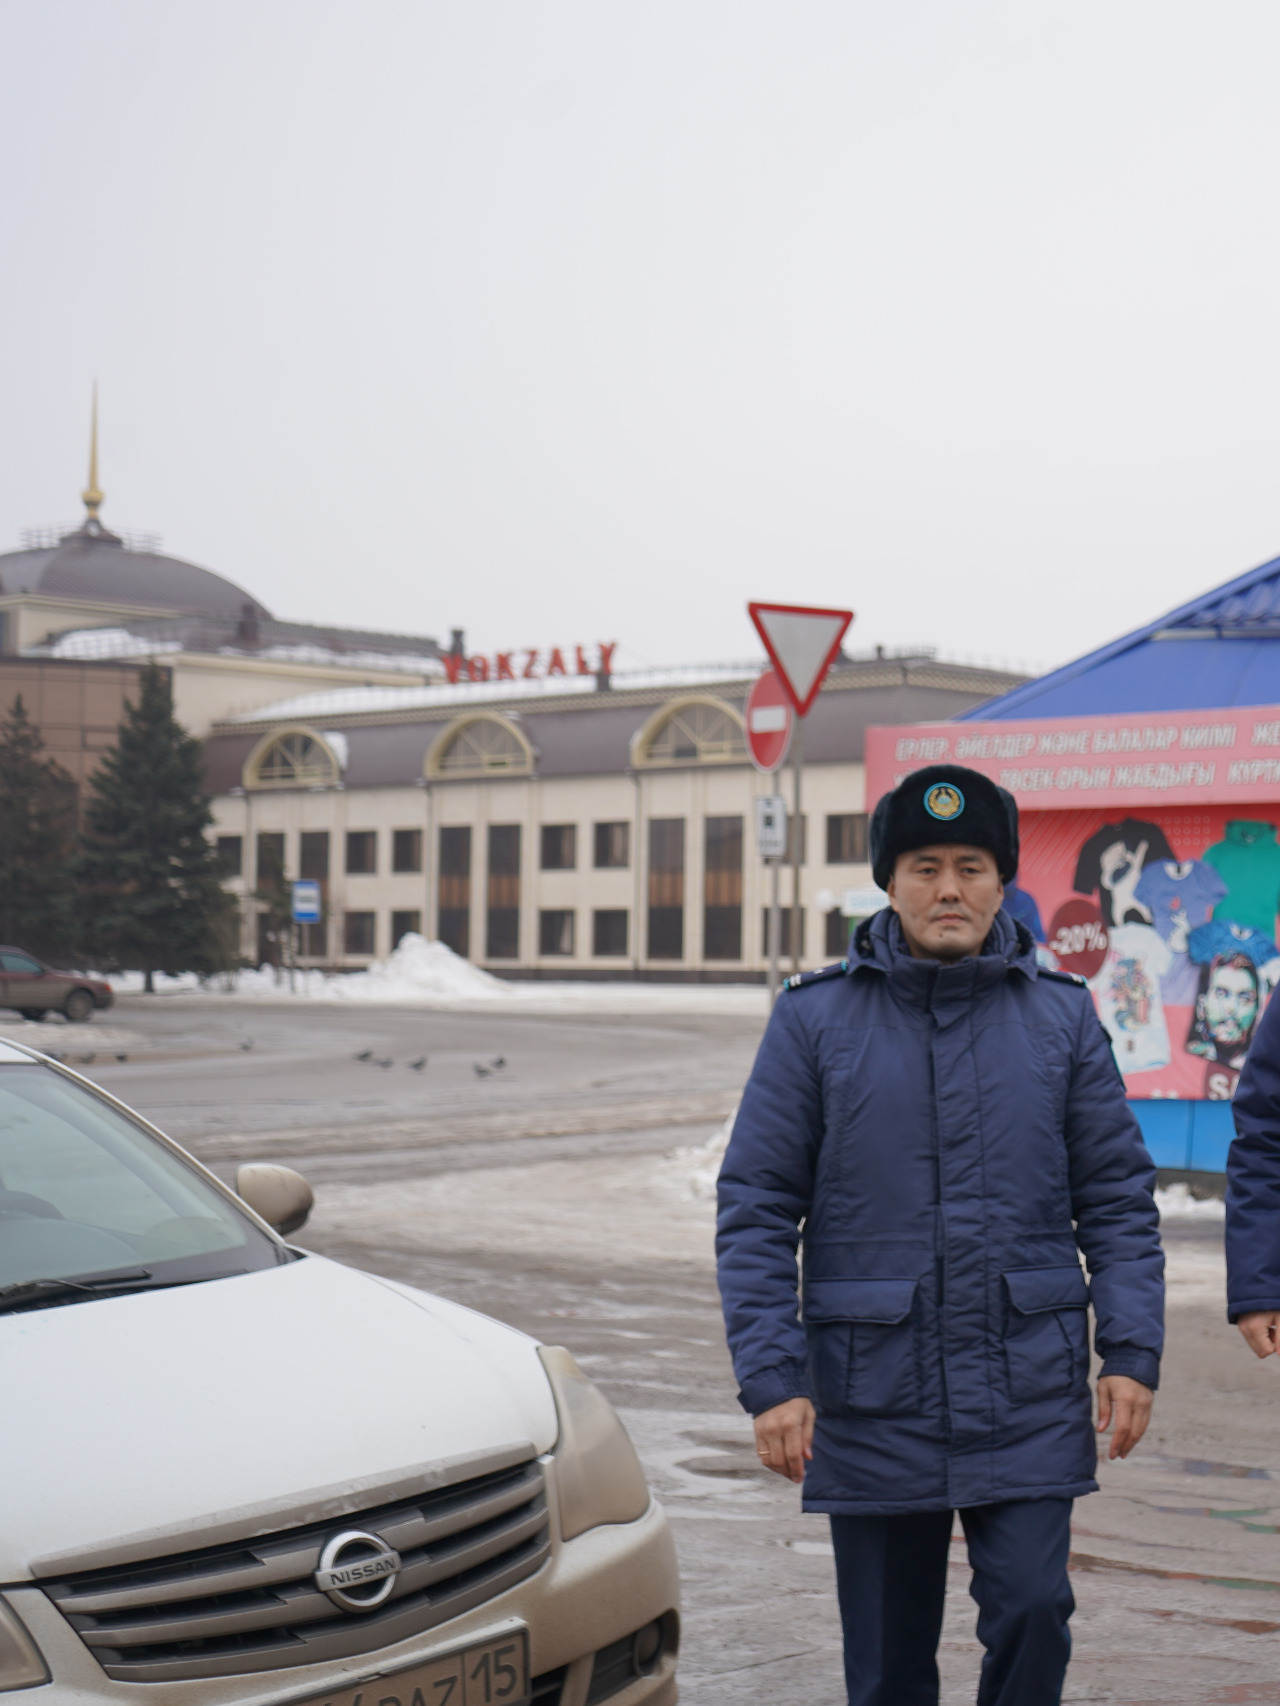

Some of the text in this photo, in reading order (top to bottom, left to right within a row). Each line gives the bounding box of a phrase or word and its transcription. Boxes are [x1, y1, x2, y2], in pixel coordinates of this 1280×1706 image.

[1092, 725, 1178, 754] БАЛАЛАР
[1049, 922, 1108, 956] -20%
[330, 1557, 397, 1585] NISSAN
[470, 1644, 517, 1703] 15
